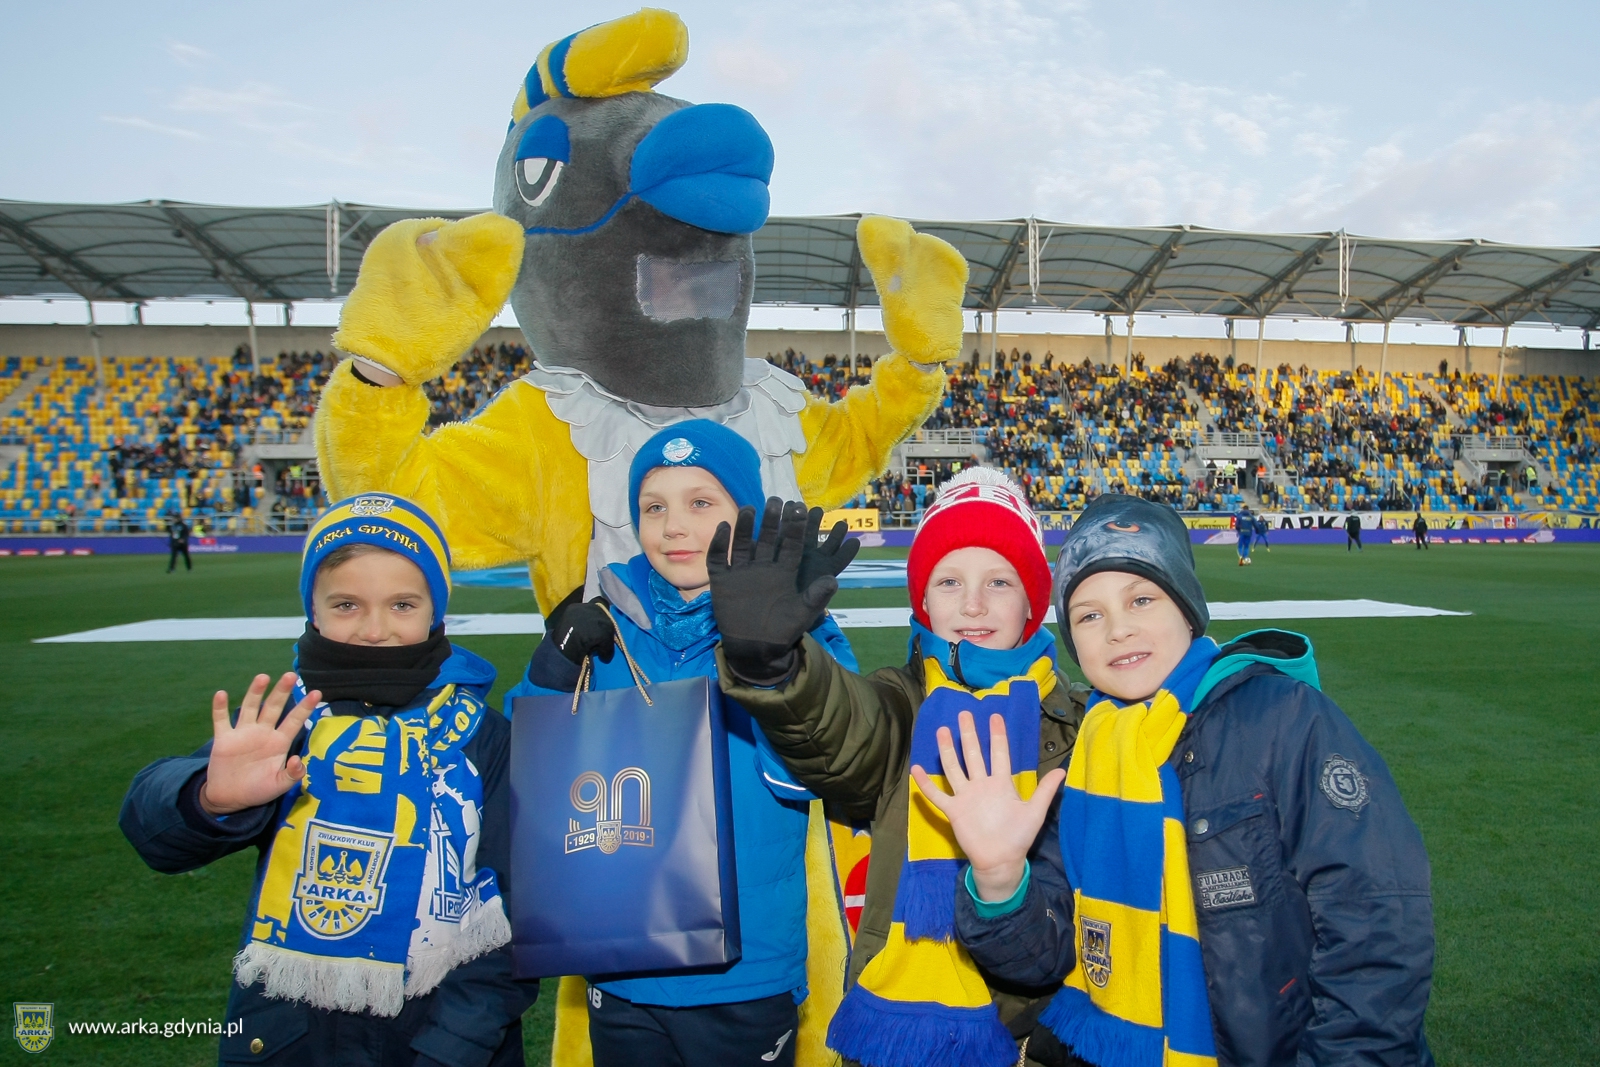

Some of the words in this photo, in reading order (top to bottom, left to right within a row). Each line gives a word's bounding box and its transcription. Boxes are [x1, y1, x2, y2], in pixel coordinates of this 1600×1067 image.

[1247, 447, 1256, 456] 17
[1280, 515, 1340, 530] ARK
[315, 526, 353, 553] ARKA
[358, 525, 420, 553] GDYNIA
[570, 766, 651, 832] 90
[318, 831, 357, 844] ZWIĄZKOWY
[357, 839, 376, 848] KLUB
[573, 833, 595, 847] 1929
[623, 830, 646, 842] 2019
[367, 850, 381, 885] SPORTOWY
[1198, 870, 1250, 887] FULLBACK
[306, 884, 367, 903] ARKA
[306, 899, 364, 930] GDYNIA
[1086, 953, 1108, 968] ARKA
